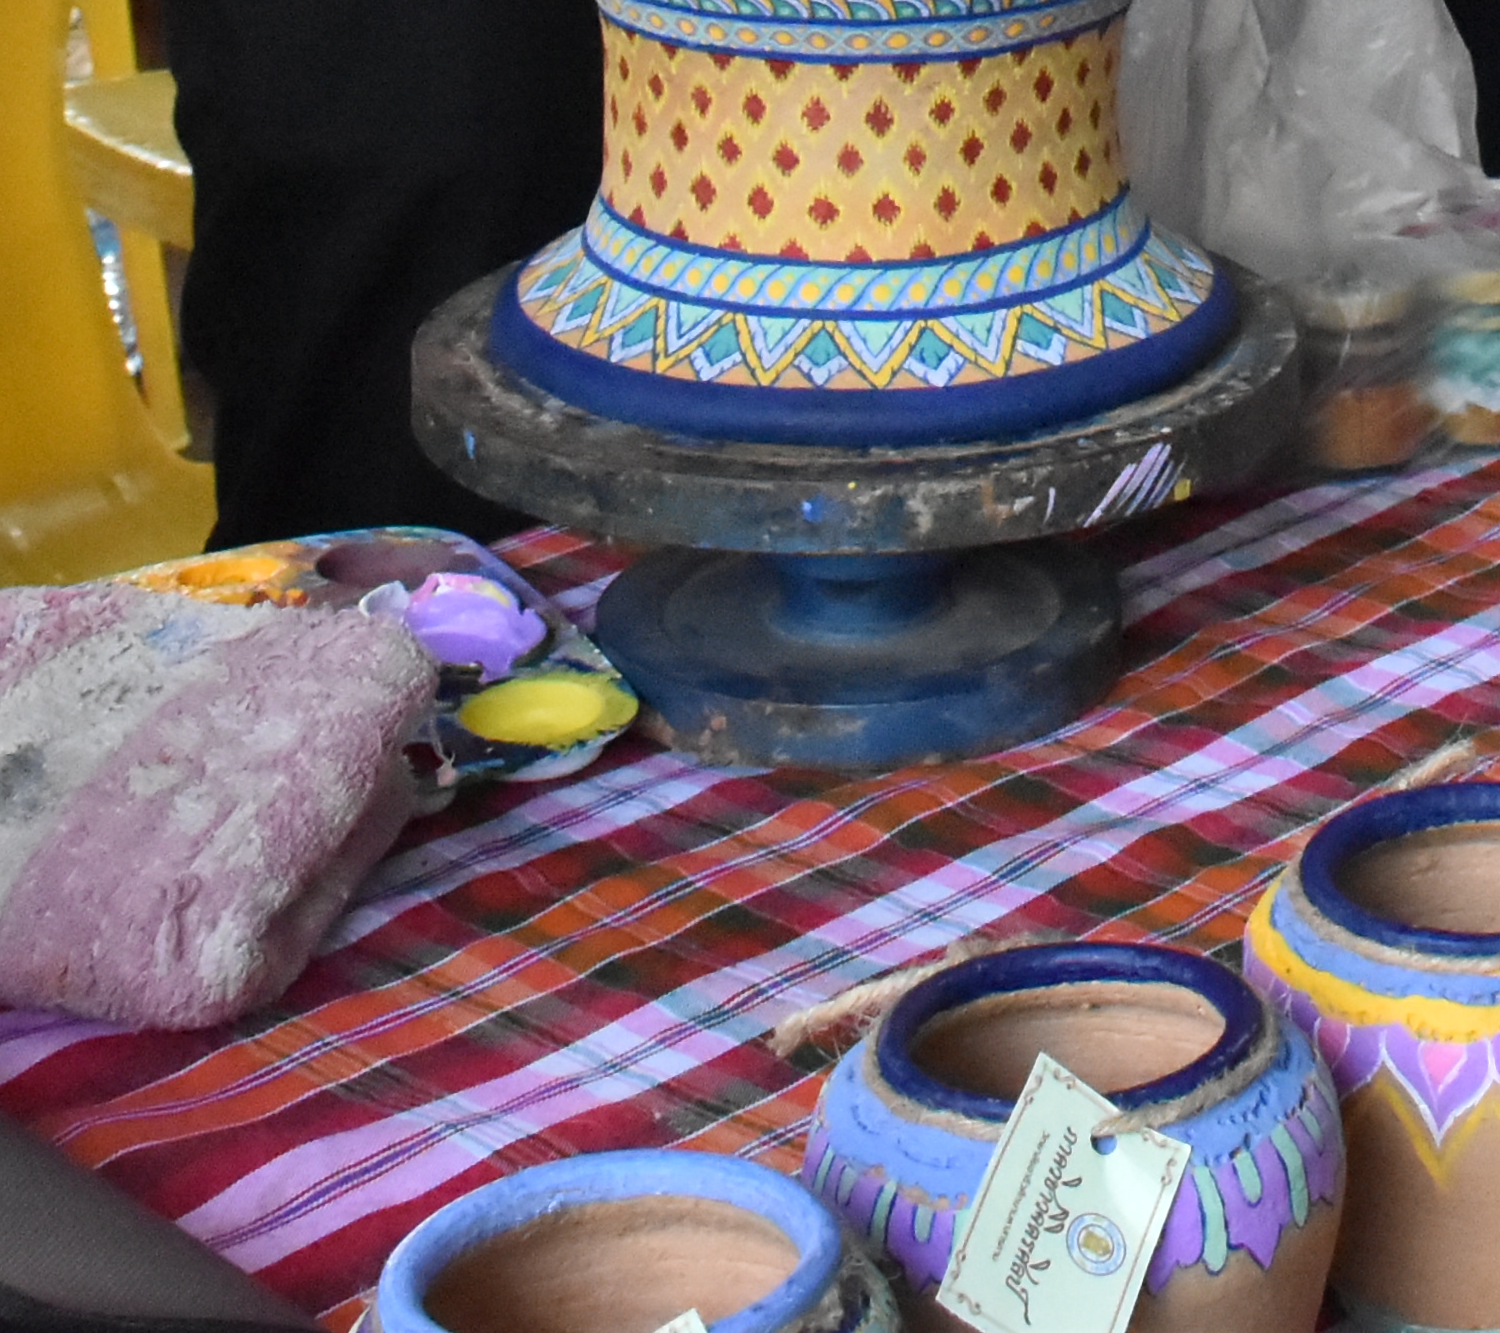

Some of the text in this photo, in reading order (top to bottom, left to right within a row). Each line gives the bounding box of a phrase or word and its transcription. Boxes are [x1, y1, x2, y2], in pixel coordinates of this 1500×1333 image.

[1004, 1126, 1083, 1326] ภาควิชาวิจิตรศิลป์
